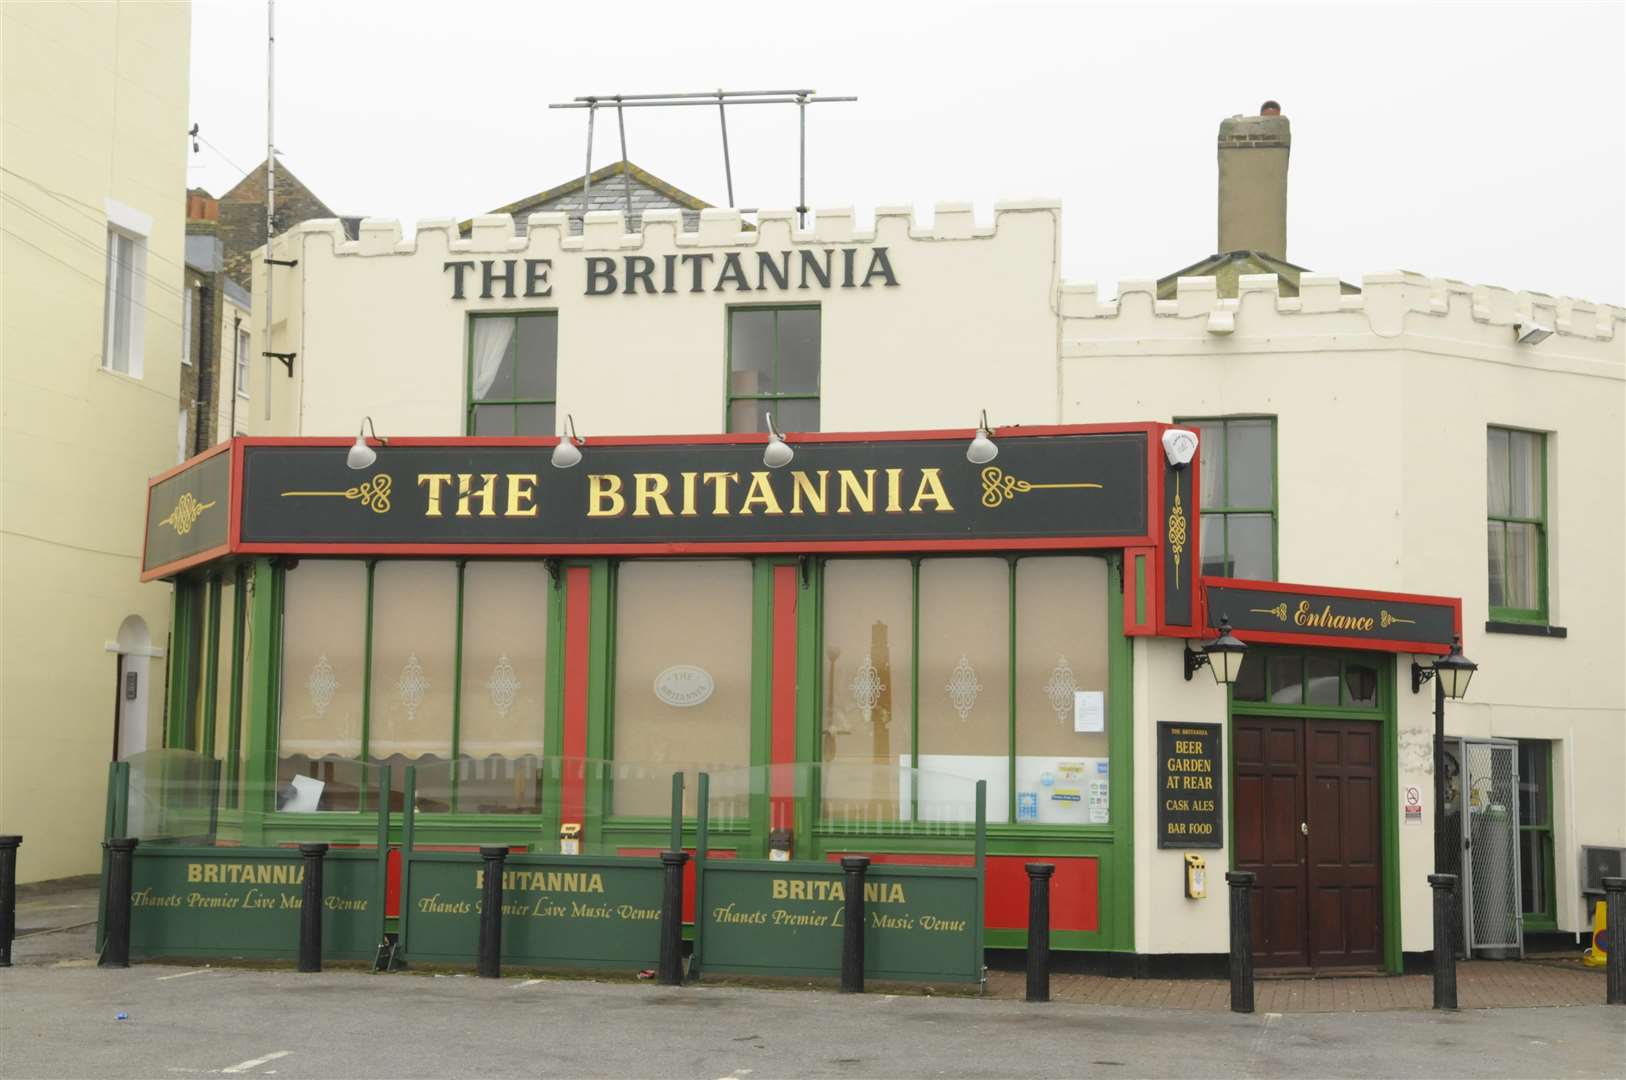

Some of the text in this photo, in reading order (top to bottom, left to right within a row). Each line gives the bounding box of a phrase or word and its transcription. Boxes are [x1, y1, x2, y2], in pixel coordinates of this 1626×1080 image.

[443, 246, 900, 299] THE BRITANNIA
[417, 468, 955, 518] THE BRITANNIA
[1294, 600, 1375, 632] Entrance
[1175, 740, 1203, 755] BEER
[1167, 758, 1212, 772] GARDEN
[1166, 775, 1213, 790] AT REAR
[1166, 800, 1215, 812] CASK ALES
[1168, 823, 1213, 834] BAR FOOD
[131, 887, 182, 906] Thanets
[187, 892, 240, 908] Premier
[242, 888, 276, 909] Live
[324, 896, 368, 911] Venue
[772, 879, 906, 903] BRITANIA
[418, 894, 471, 914] Thanets
[532, 896, 567, 917] Live
[571, 901, 613, 919] Music
[616, 905, 662, 920] Venue
[713, 903, 767, 924] Thanets
[771, 909, 828, 927] Premier
[872, 911, 914, 930] Music
[919, 915, 966, 931] Venue
